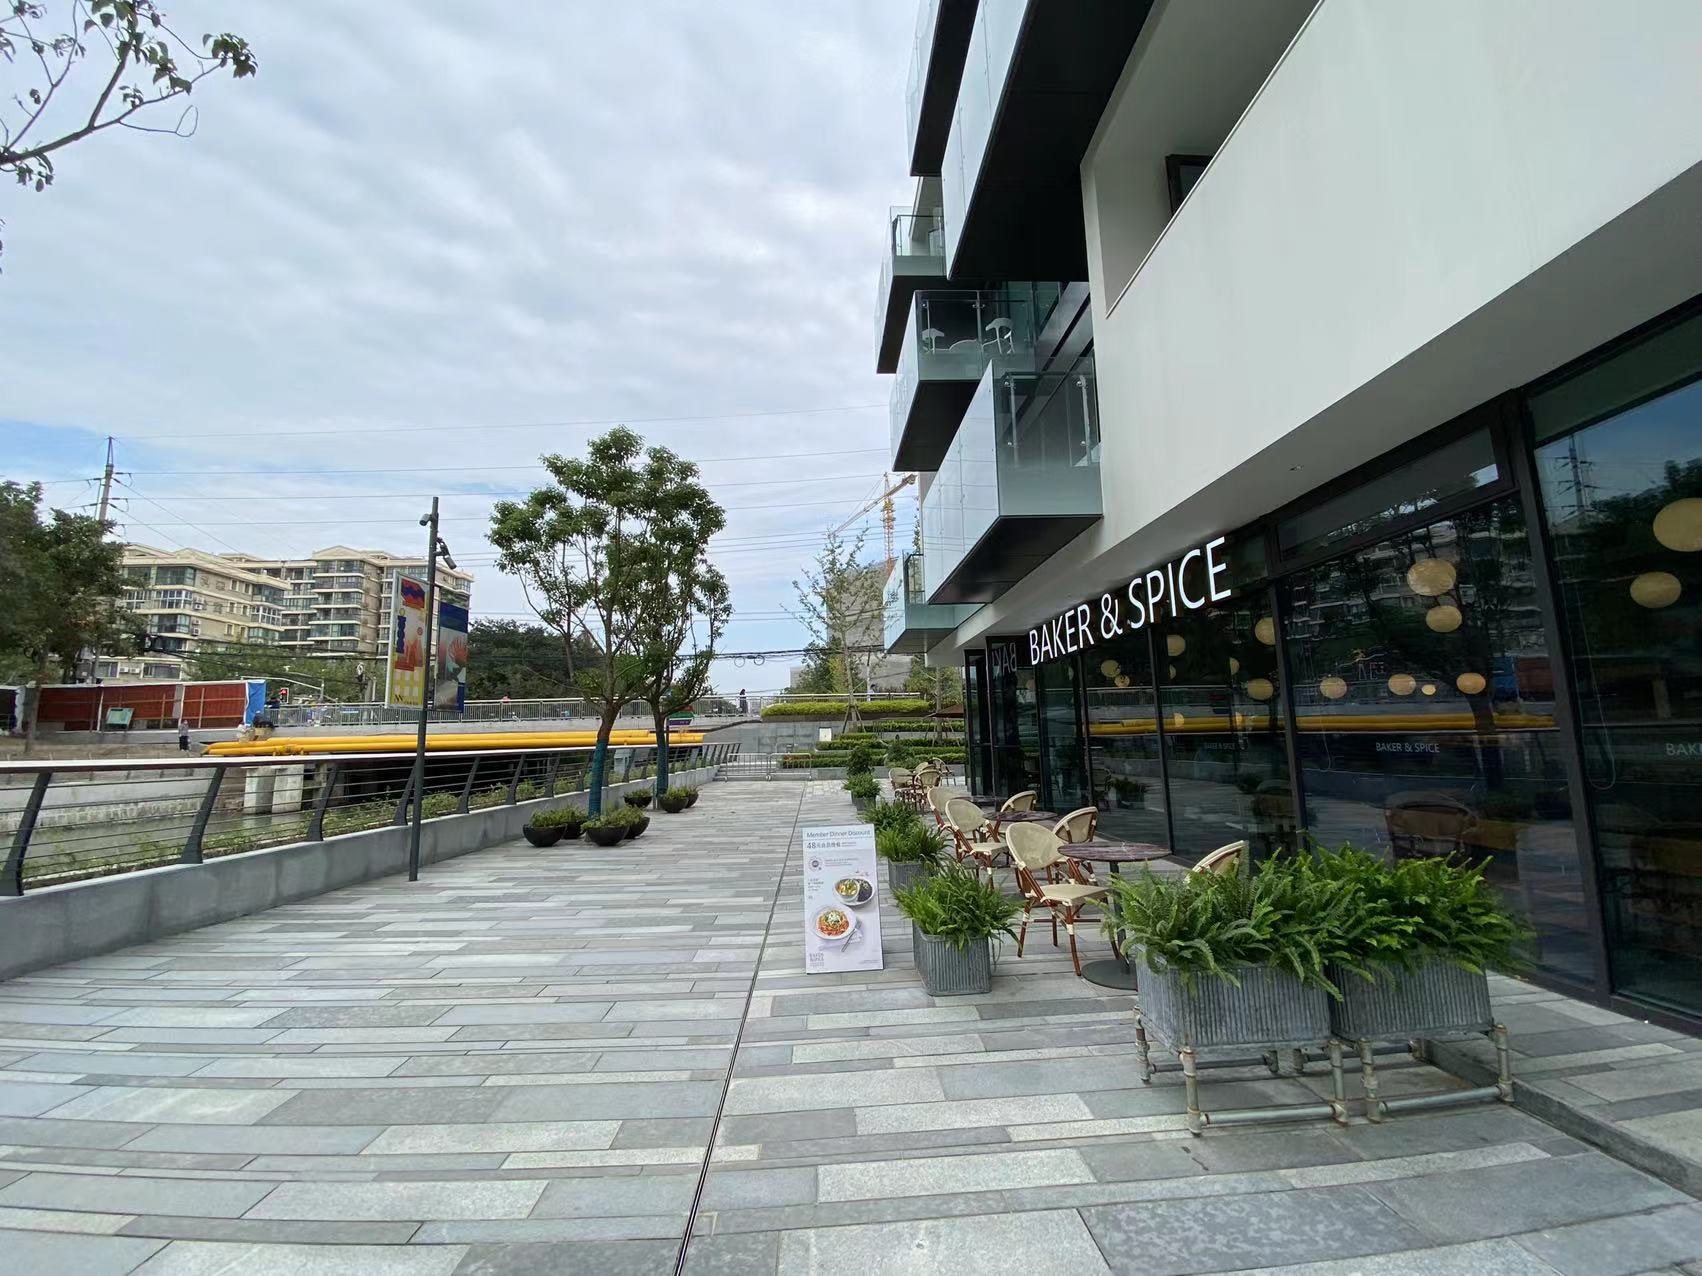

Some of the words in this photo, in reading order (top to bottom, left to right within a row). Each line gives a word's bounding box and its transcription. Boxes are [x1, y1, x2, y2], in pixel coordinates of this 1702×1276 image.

[1029, 603, 1094, 666] BAKER
[1101, 593, 1123, 639] &
[1128, 536, 1232, 630] SPICE
[1375, 742, 1403, 752] BAKER
[1404, 742, 1413, 752] &
[1414, 742, 1440, 753] SPICE
